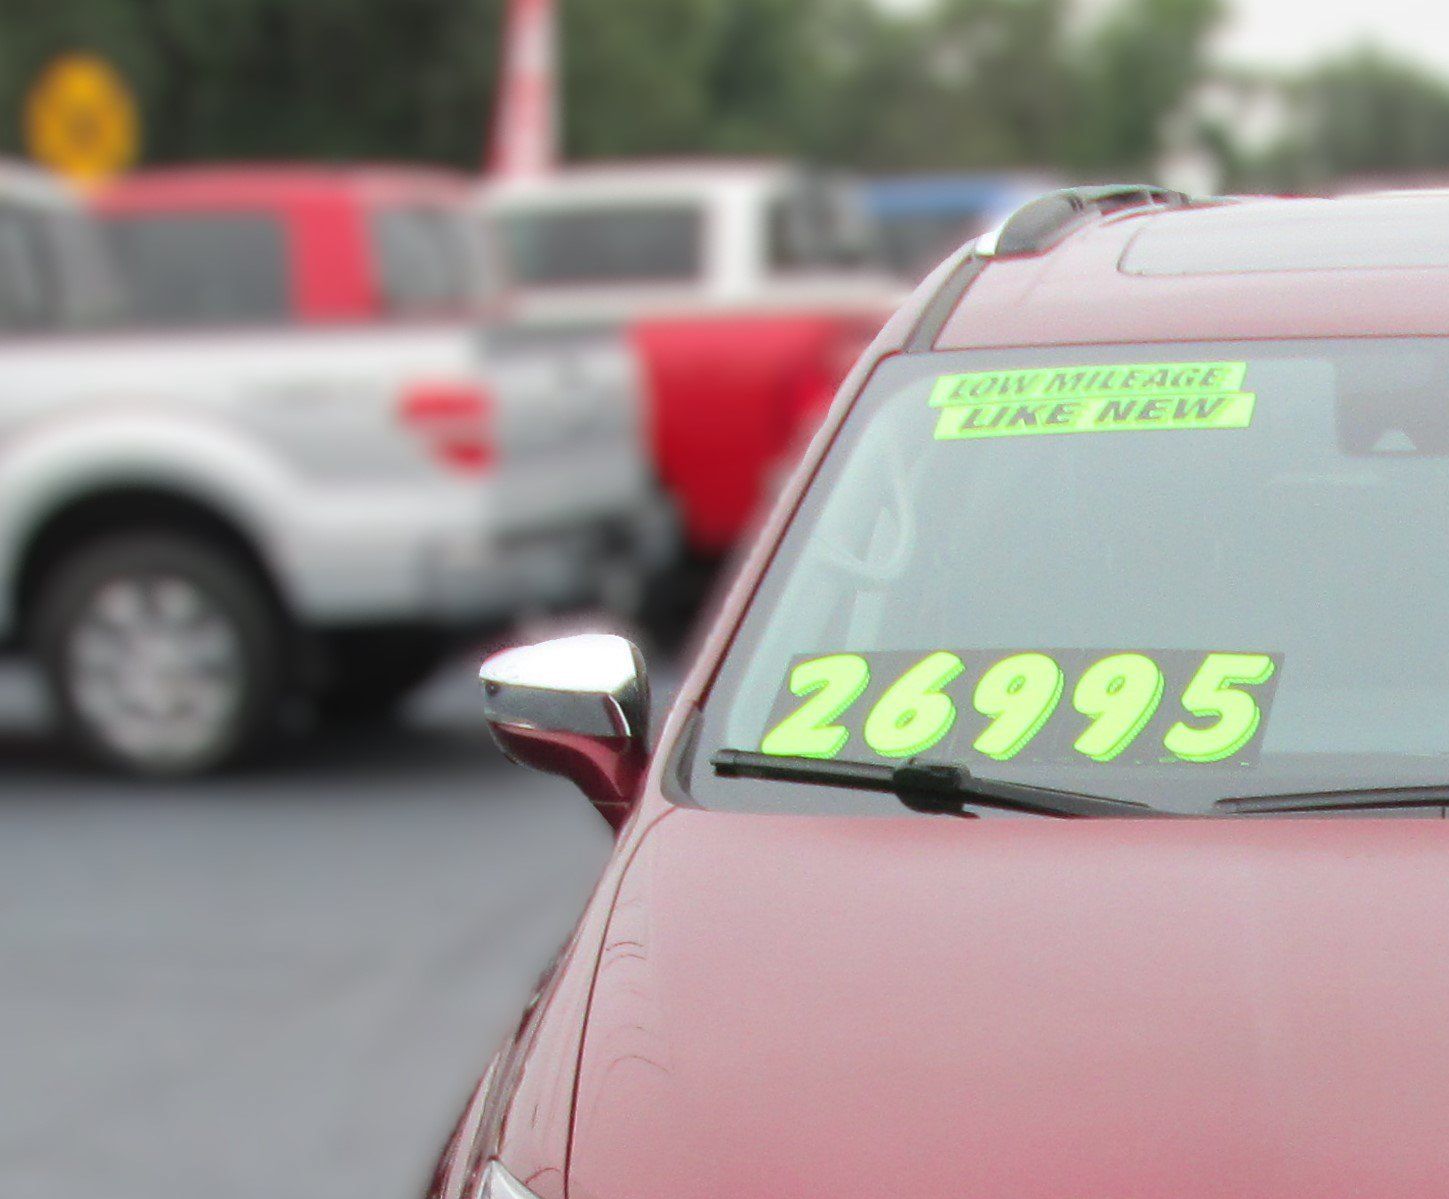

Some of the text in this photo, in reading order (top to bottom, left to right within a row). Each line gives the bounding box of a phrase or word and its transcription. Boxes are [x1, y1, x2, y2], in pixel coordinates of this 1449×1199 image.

[950, 367, 1226, 399] LOW MILEAGE
[960, 397, 1226, 430] LIKE NEW
[761, 651, 1275, 763] 26995
